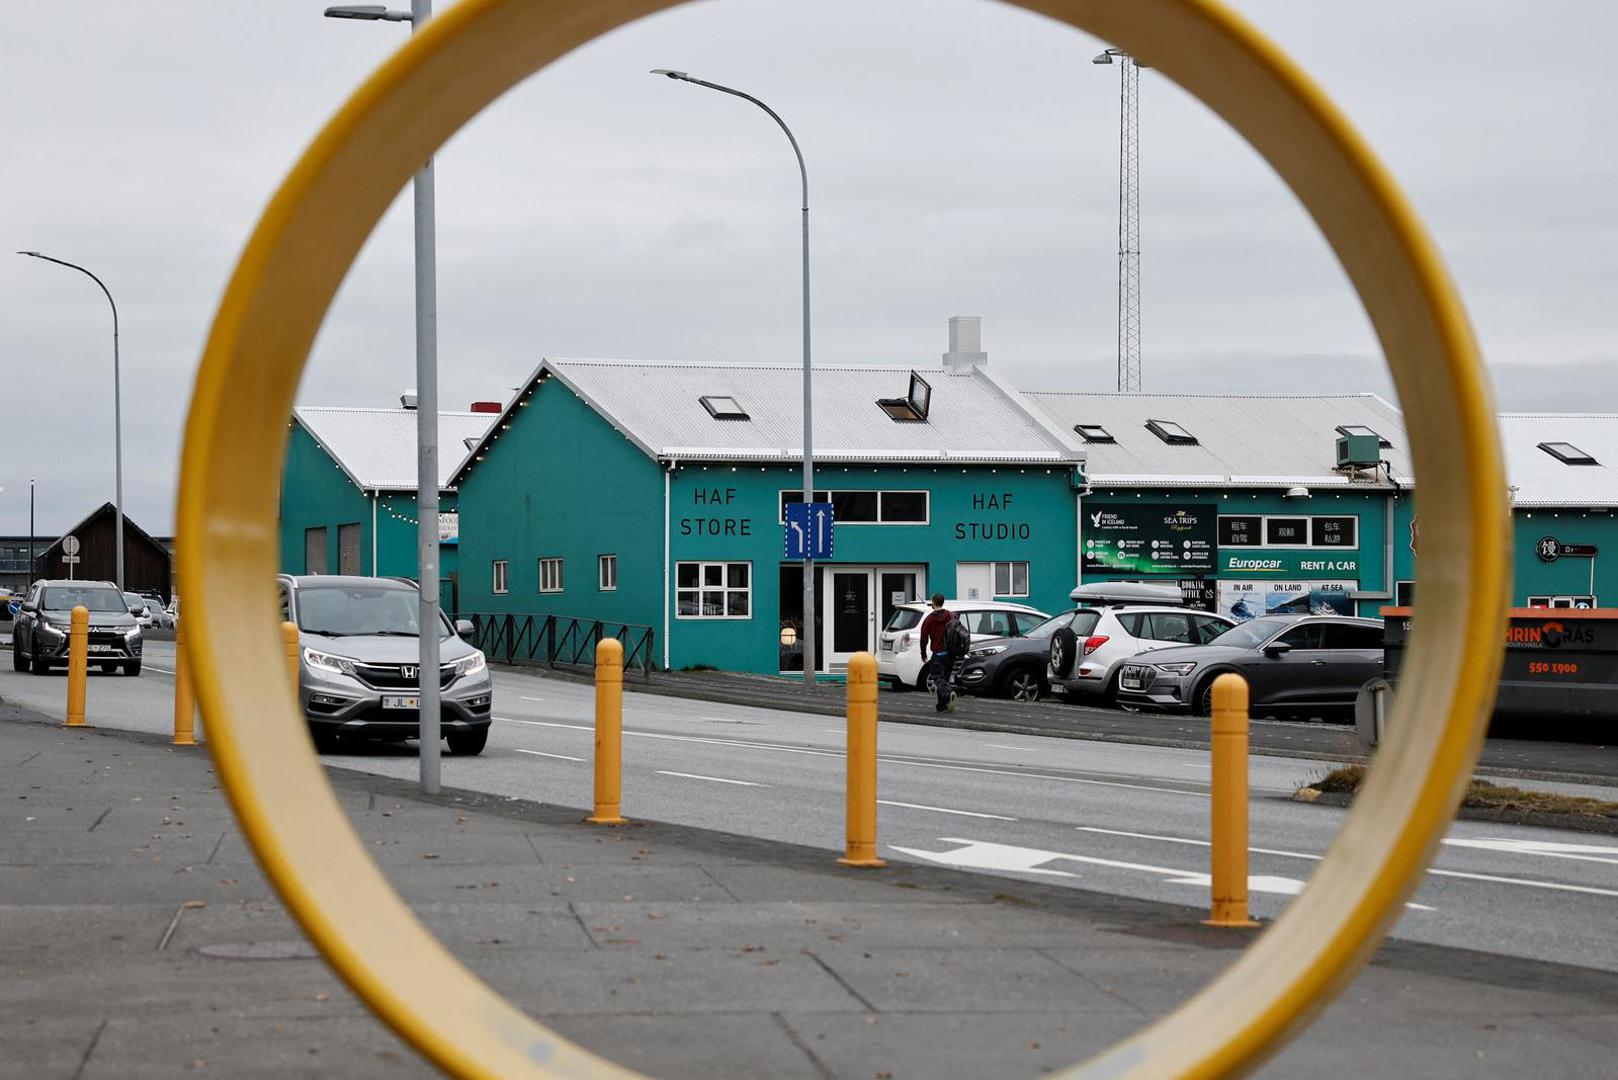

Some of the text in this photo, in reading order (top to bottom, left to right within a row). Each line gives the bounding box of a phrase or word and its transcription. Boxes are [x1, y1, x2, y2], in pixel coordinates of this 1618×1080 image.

[694, 488, 736, 505] HAF
[973, 493, 1012, 510] HAF
[681, 519, 751, 536] STORE
[955, 523, 1030, 540] STUDIO
[1228, 558, 1282, 570] Europcar
[1301, 561, 1356, 570] RENT A CAR
[1181, 581, 1205, 589] BOOKING
[1529, 662, 1577, 673] 550 1900
